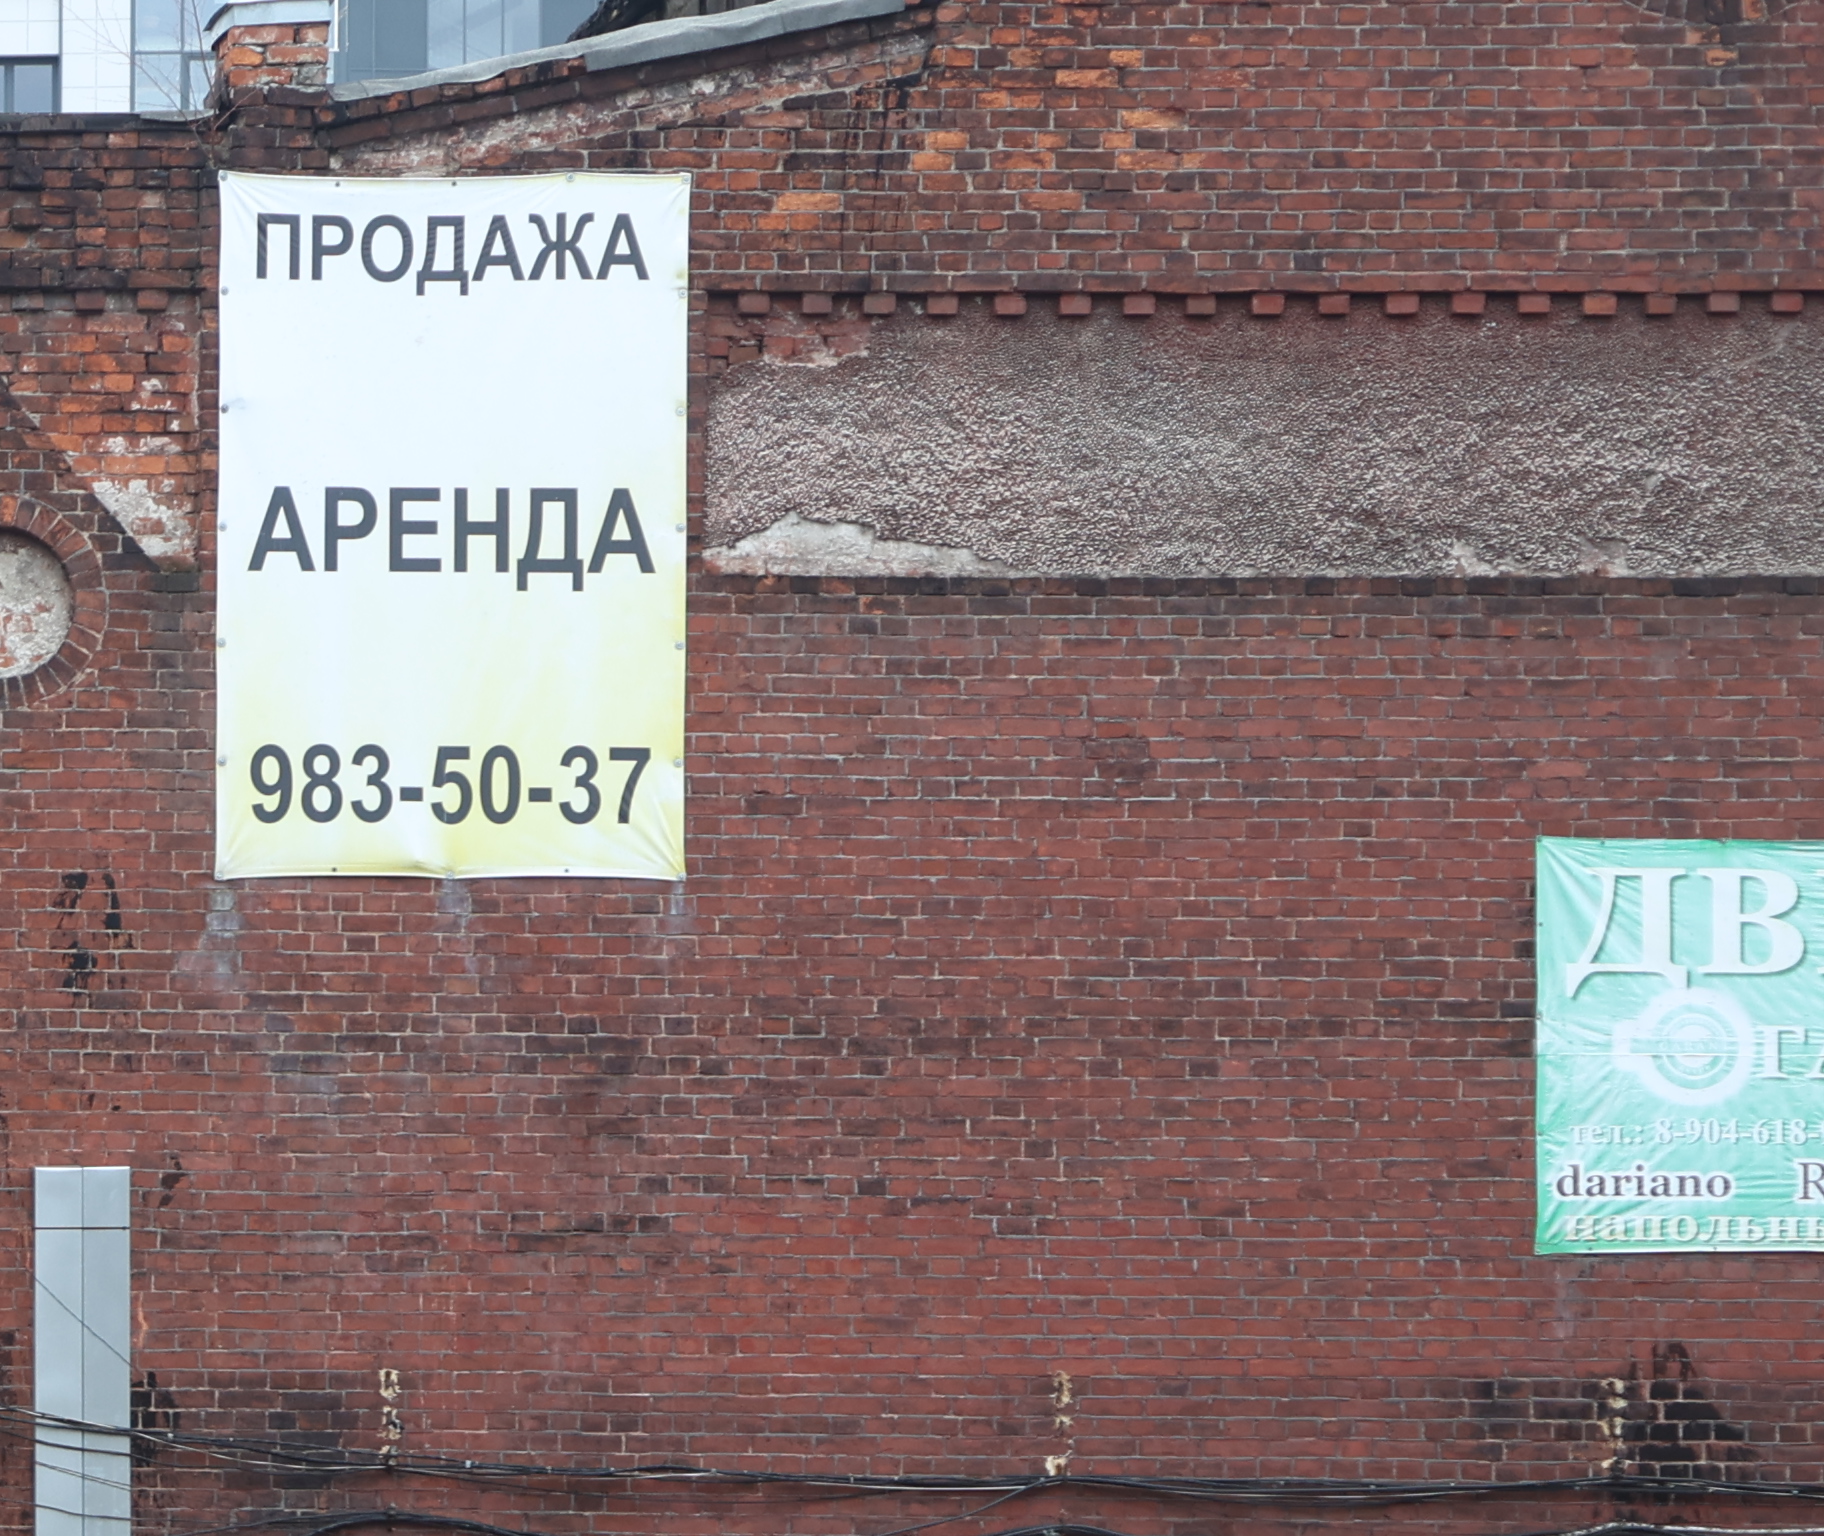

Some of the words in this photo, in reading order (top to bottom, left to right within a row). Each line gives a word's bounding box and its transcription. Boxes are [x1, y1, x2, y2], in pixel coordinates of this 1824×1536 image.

[255, 212, 650, 296] ПРОДАЖА
[248, 486, 657, 592] АРЕНДА
[250, 743, 653, 825] 983-50-37
[1566, 867, 1824, 999] ДВ
[1569, 1124, 1645, 1145] тел.:
[1655, 1118, 1824, 1146] 8-904-618-
[1556, 1164, 1733, 1199] dariano
